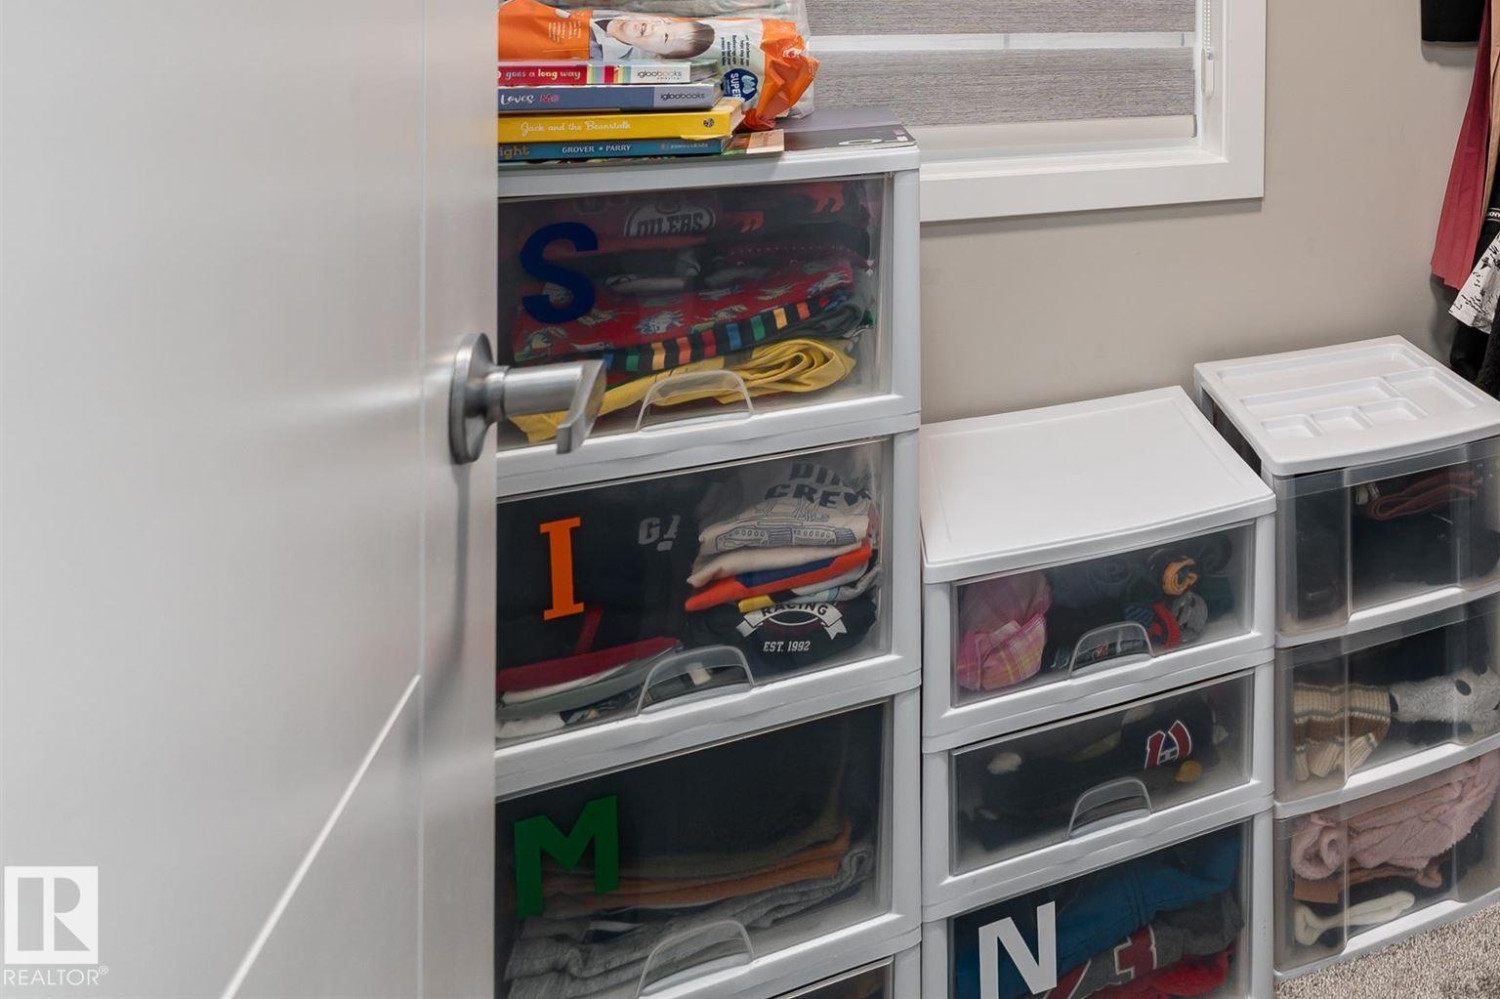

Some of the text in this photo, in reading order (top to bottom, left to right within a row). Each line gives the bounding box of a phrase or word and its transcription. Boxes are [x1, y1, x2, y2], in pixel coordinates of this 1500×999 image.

[506, 70, 527, 80] goes
[538, 68, 558, 80] long
[560, 71, 582, 79] way
[637, 69, 682, 78] igloobooks
[500, 94, 535, 105] Loves
[661, 92, 705, 101] igloobooks
[520, 120, 632, 136] Jack and the Beanstalk
[562, 144, 632, 153] GROVER PARRY
[519, 222, 598, 323] S
[539, 516, 586, 621] I
[763, 640, 811, 652] EST. 1992
[514, 795, 620, 919] M
[978, 901, 1058, 999] N
